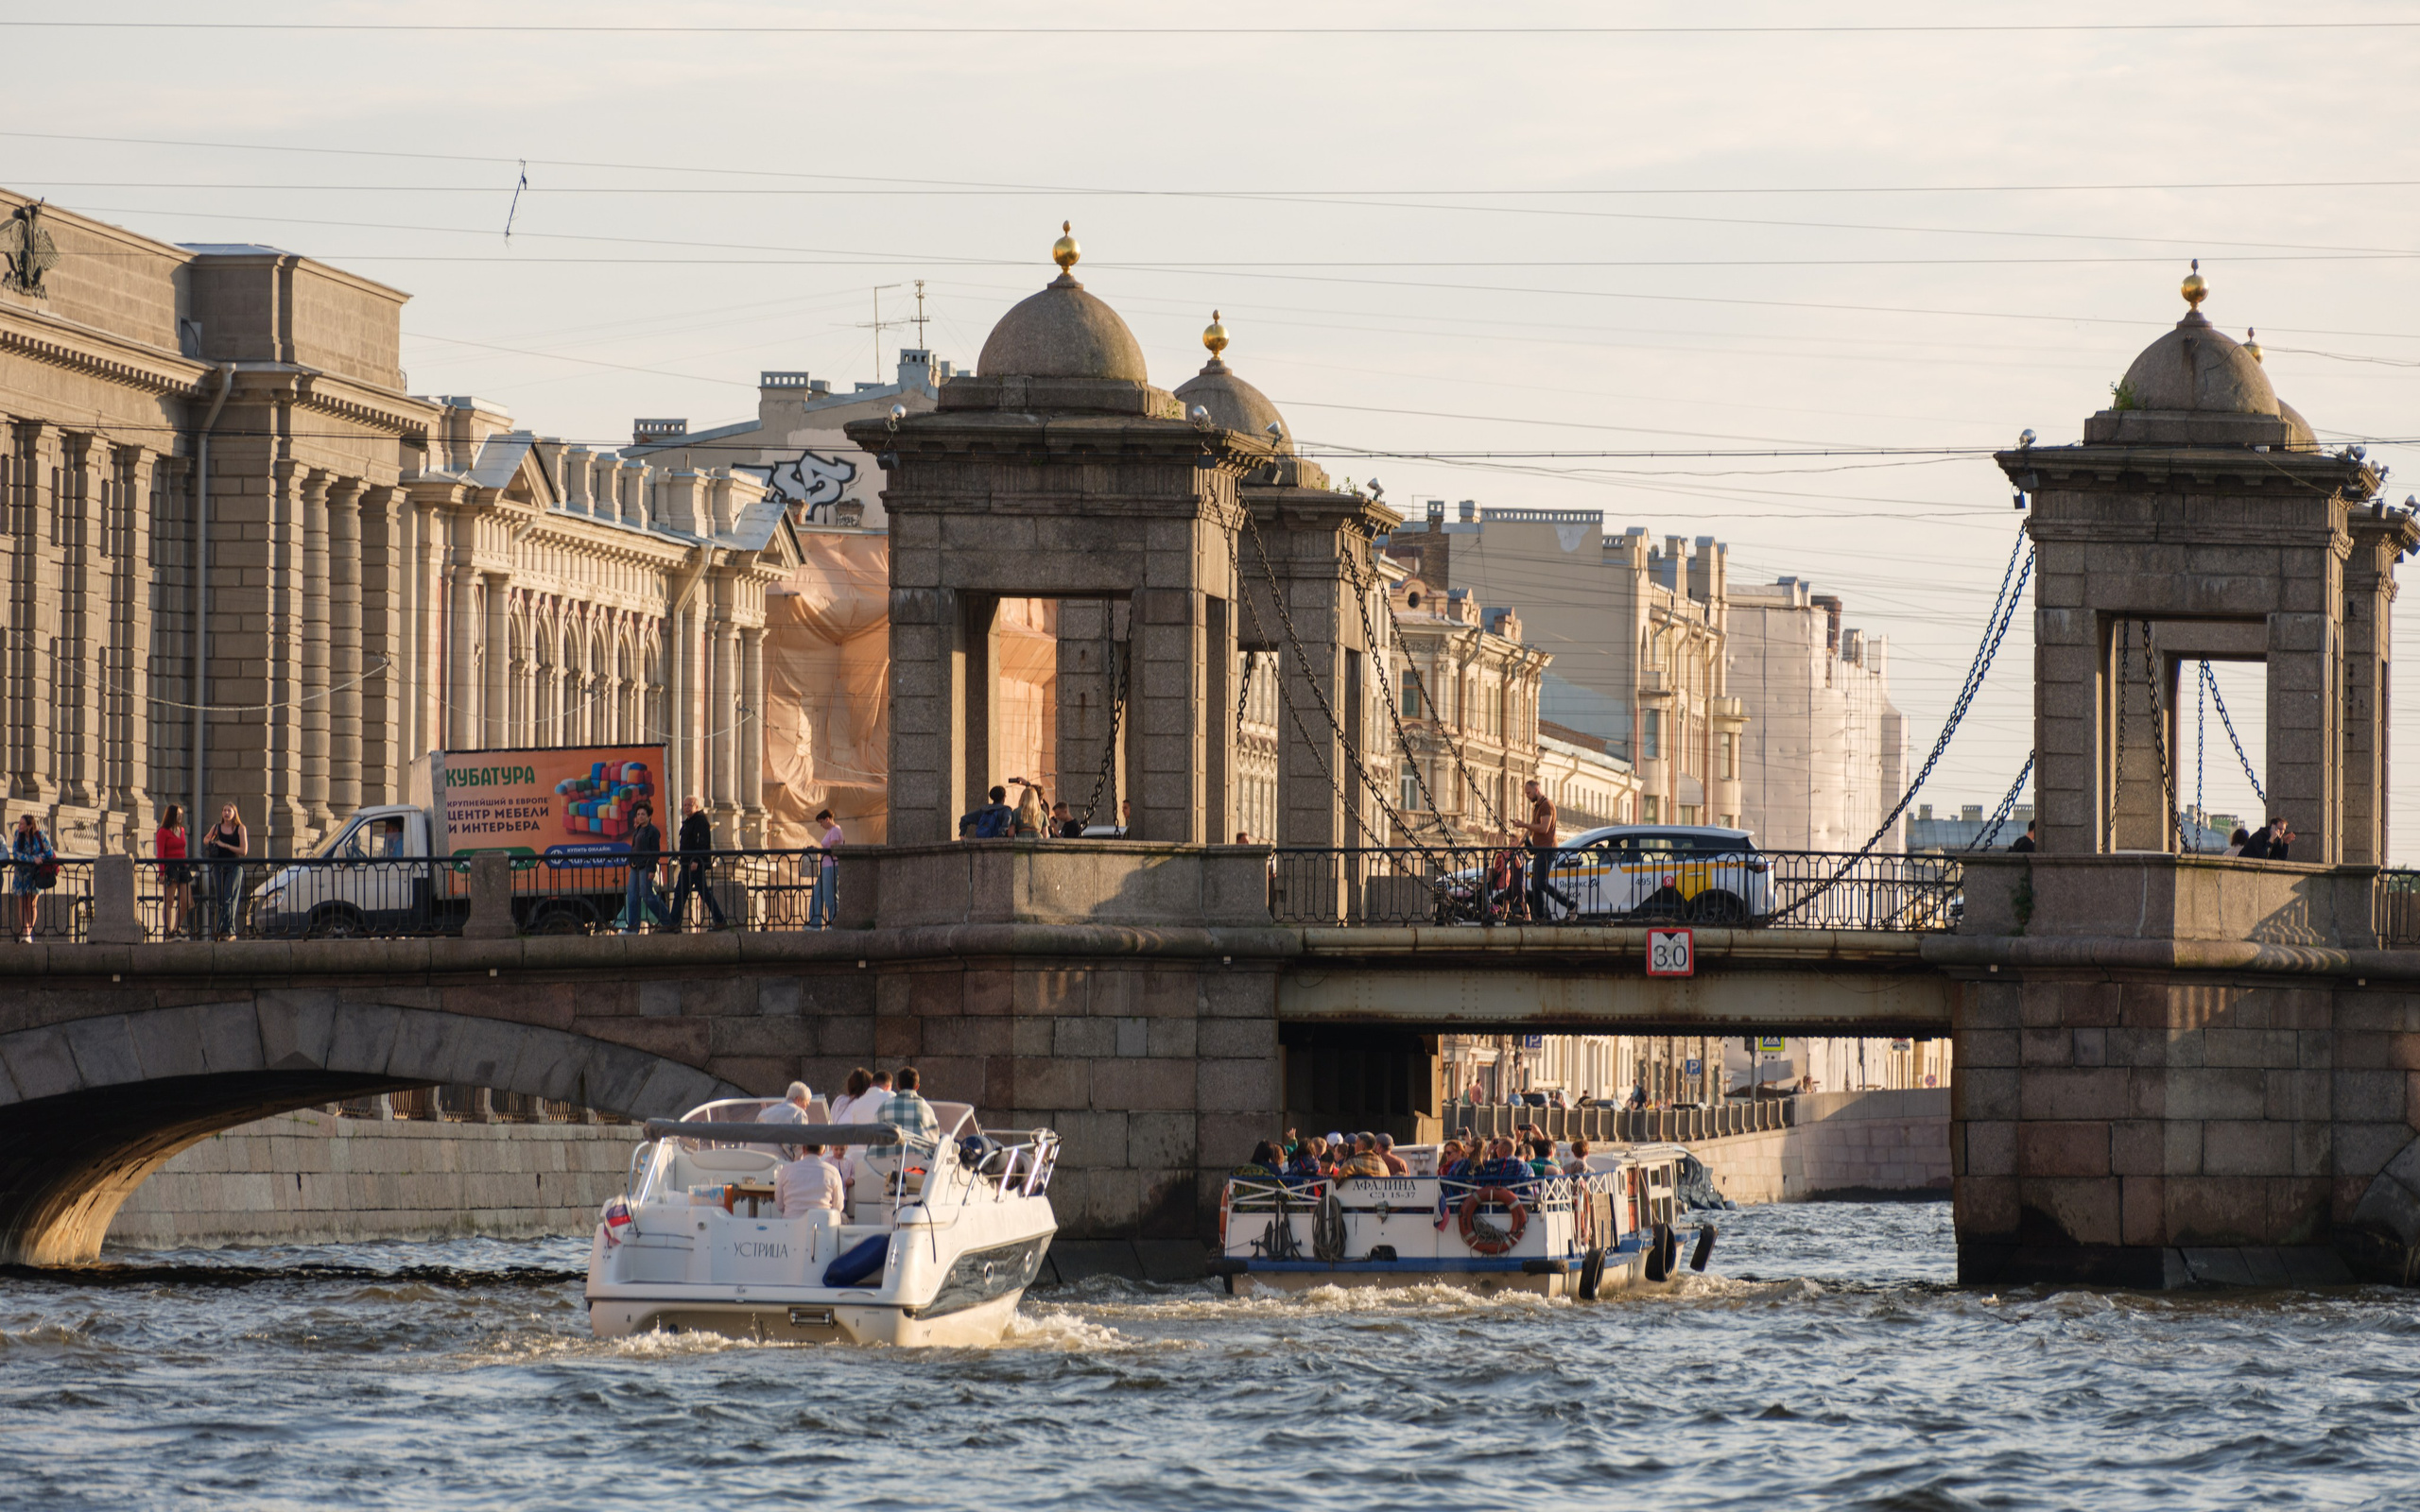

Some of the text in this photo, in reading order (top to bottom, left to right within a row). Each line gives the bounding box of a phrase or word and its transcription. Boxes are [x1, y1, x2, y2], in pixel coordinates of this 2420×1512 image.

[445, 765, 535, 787] КУБАТУРА
[447, 798, 506, 808] КРУПНЕЙШИЙ
[447, 807, 549, 821] ЦЕНТР МЕБЕЛИ
[448, 820, 541, 833] И ИНТЕРЬЕРА
[1635, 878, 1651, 886] 495
[1689, 1060, 1700, 1074] P
[1353, 1180, 1416, 1191] АФАЛИНА
[734, 1242, 788, 1258] УСТРИЦА
